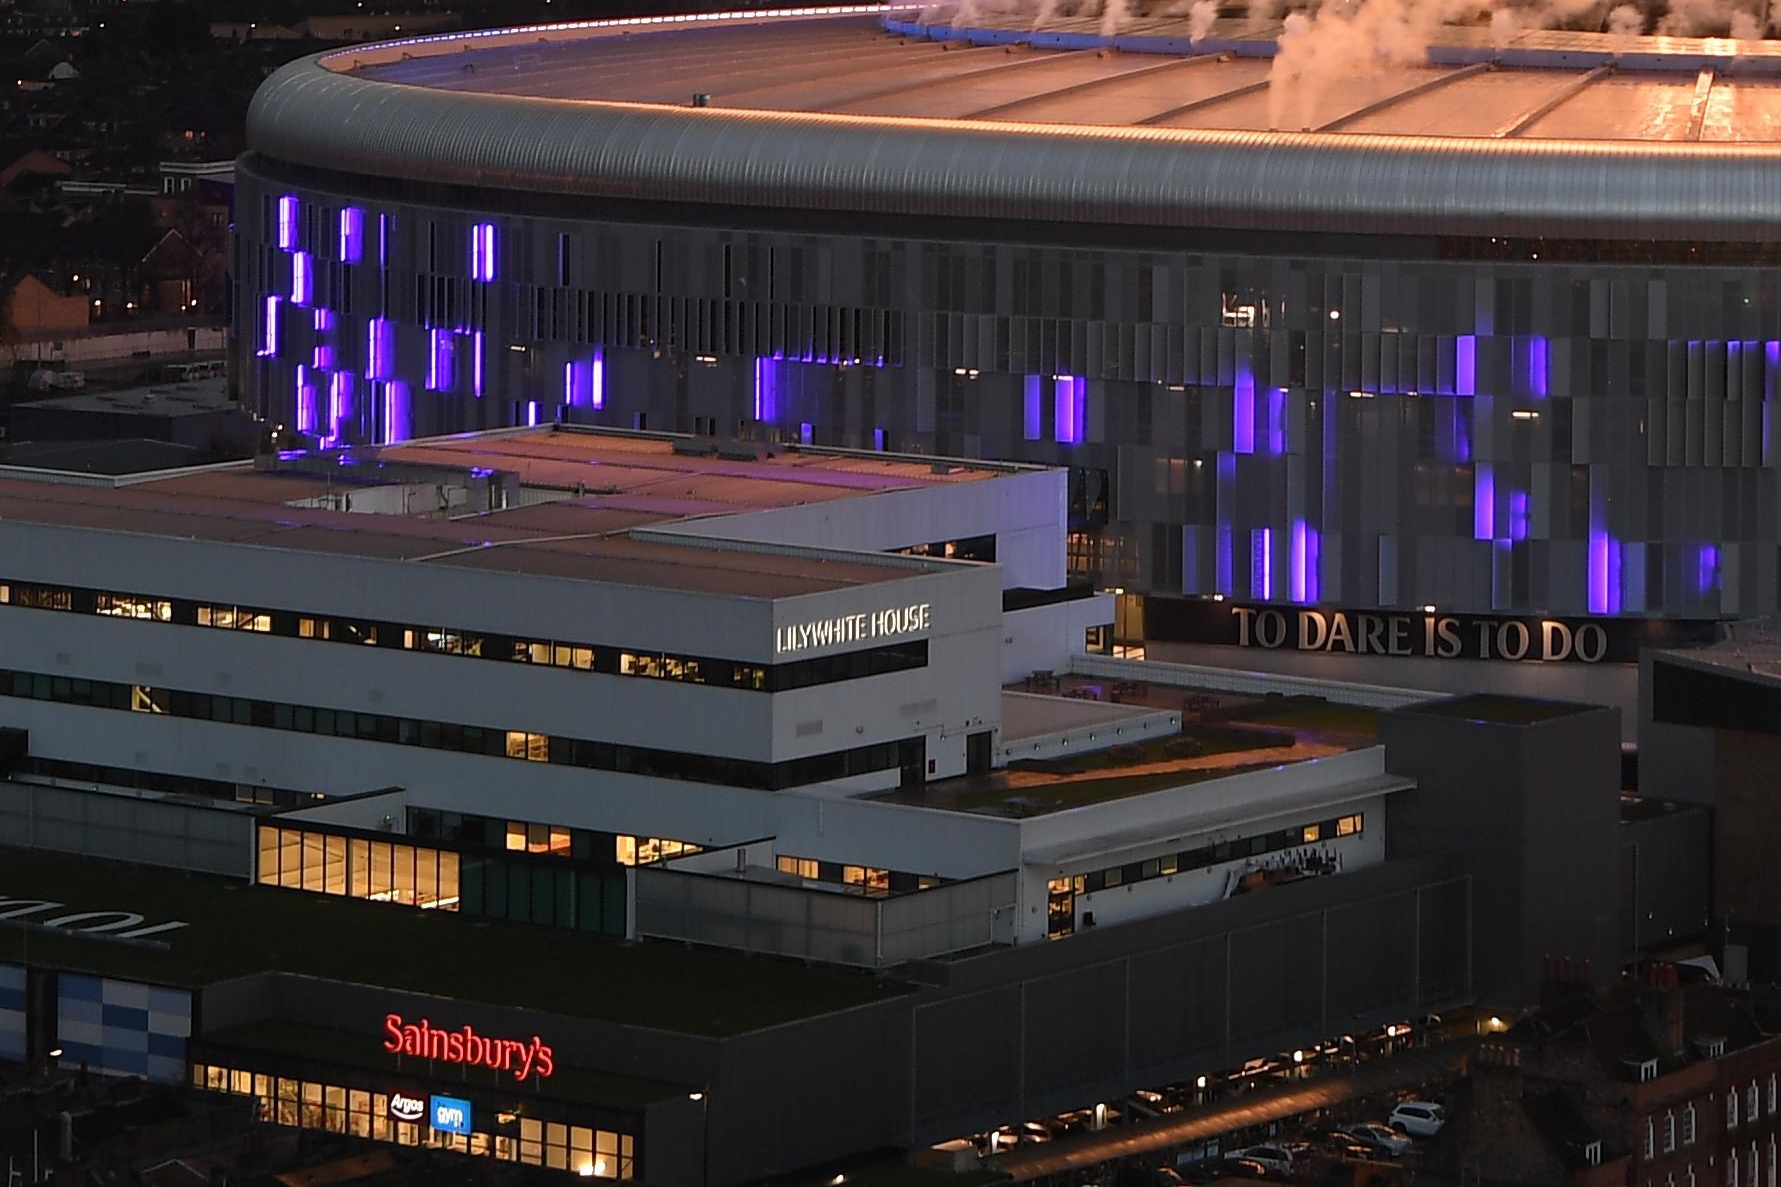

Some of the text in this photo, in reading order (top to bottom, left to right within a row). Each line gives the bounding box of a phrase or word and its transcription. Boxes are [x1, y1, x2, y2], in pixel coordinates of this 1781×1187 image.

[776, 603, 931, 654] LILYWHITE HOUSE
[1231, 606, 1608, 663] TO DARE IS TO DO
[383, 1013, 554, 1082] Sainsbury's
[390, 1093, 425, 1114] Argos
[436, 1106, 464, 1128] gym
